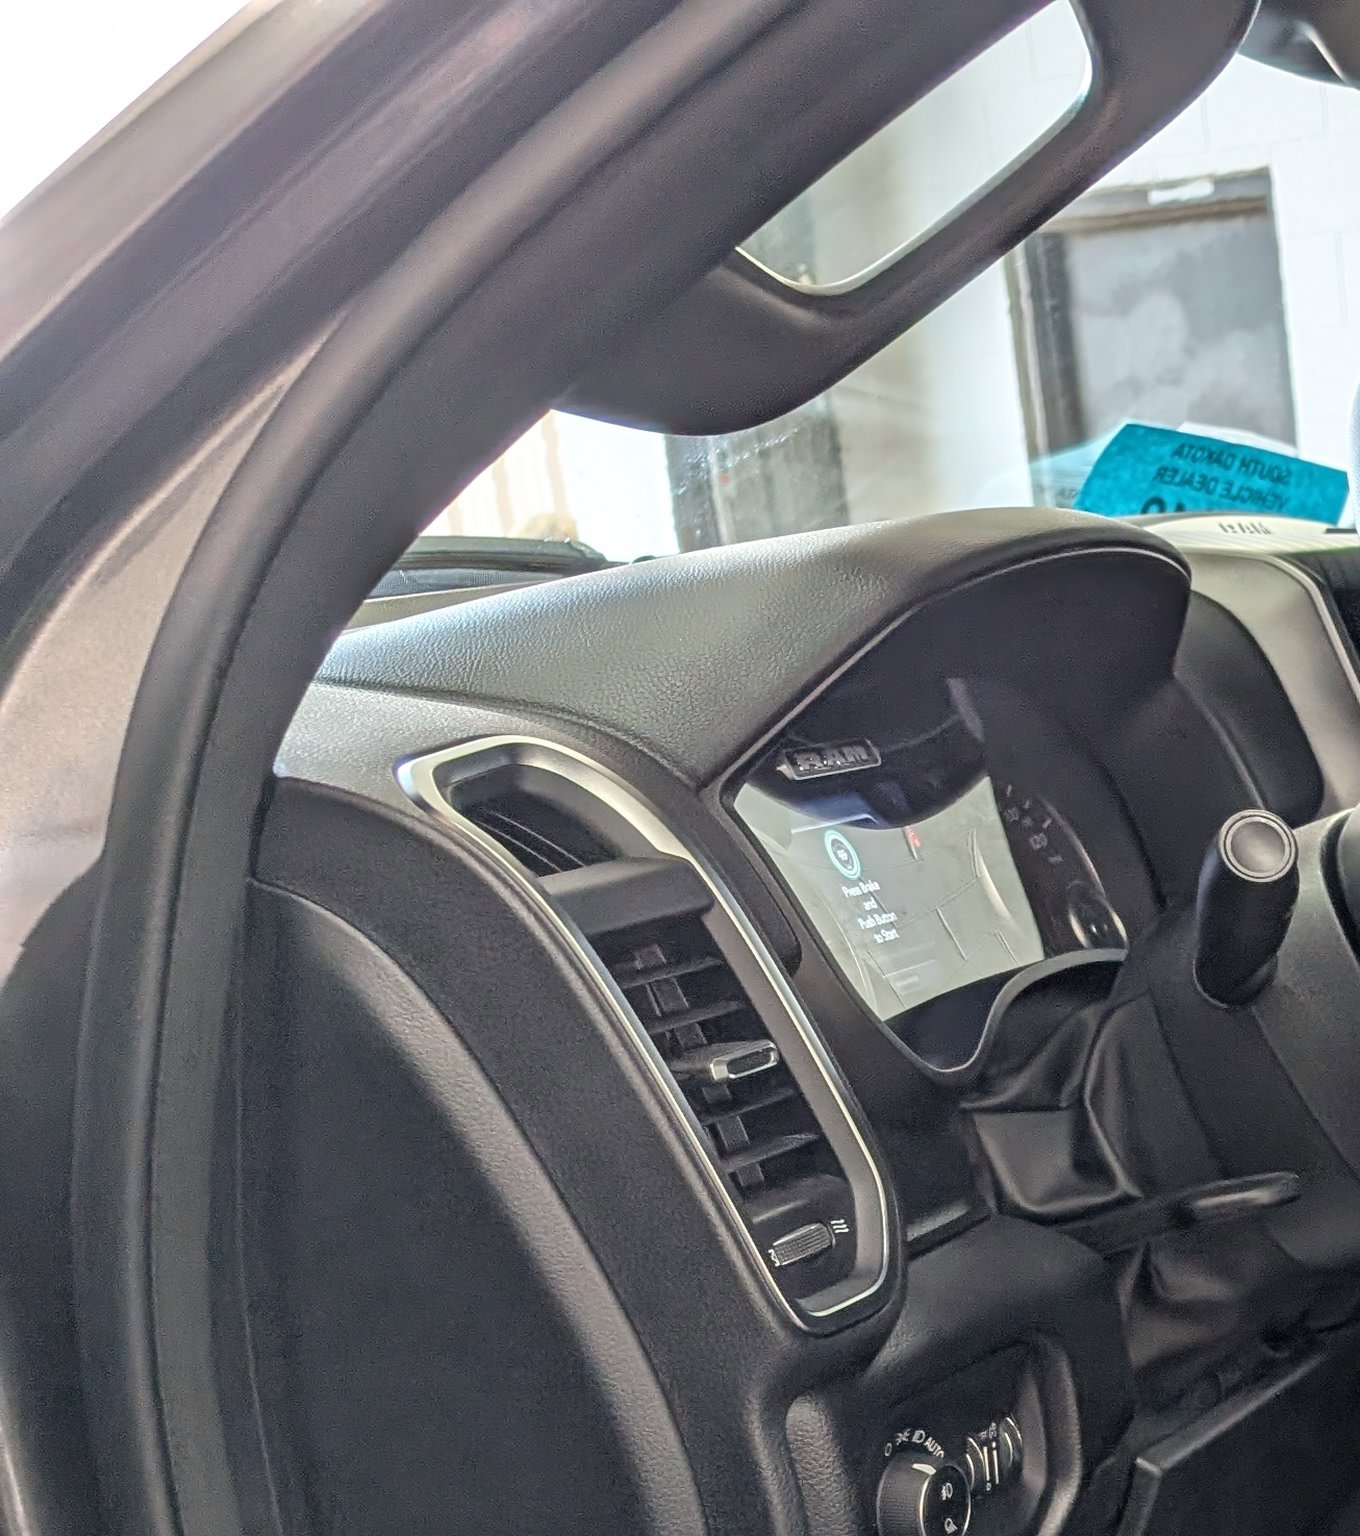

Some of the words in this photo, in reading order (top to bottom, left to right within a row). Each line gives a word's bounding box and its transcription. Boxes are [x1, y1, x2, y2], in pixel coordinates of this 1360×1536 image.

[842, 886, 862, 898] Press
[859, 879, 881, 894] Brake
[863, 896, 878, 911] and
[857, 915, 877, 929] Push
[873, 912, 898, 926] Button
[874, 933, 884, 944] to
[881, 928, 900, 941] Start
[924, 1437, 945, 1459] AUTO
